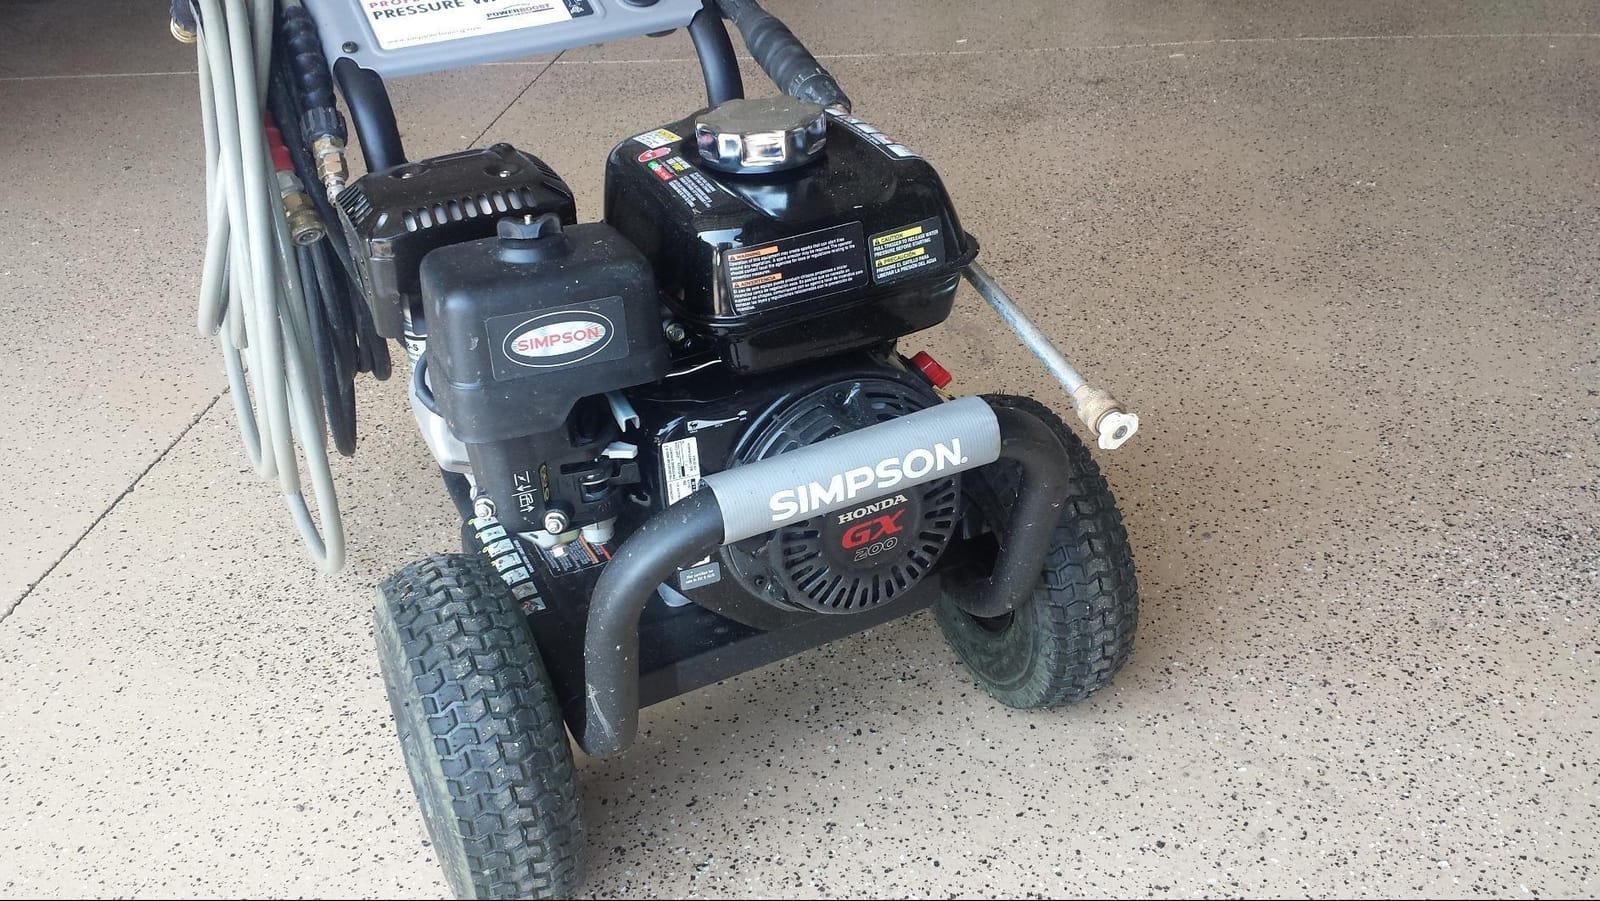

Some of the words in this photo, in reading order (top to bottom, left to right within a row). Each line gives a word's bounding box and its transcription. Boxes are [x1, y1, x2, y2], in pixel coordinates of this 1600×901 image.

[373, 0, 464, 20] PRESSURE
[881, 234, 903, 242] CAUTION
[518, 327, 600, 352] SIMPSON
[838, 494, 908, 525] HONDA
[841, 508, 906, 549] GX
[854, 536, 898, 562] 200
